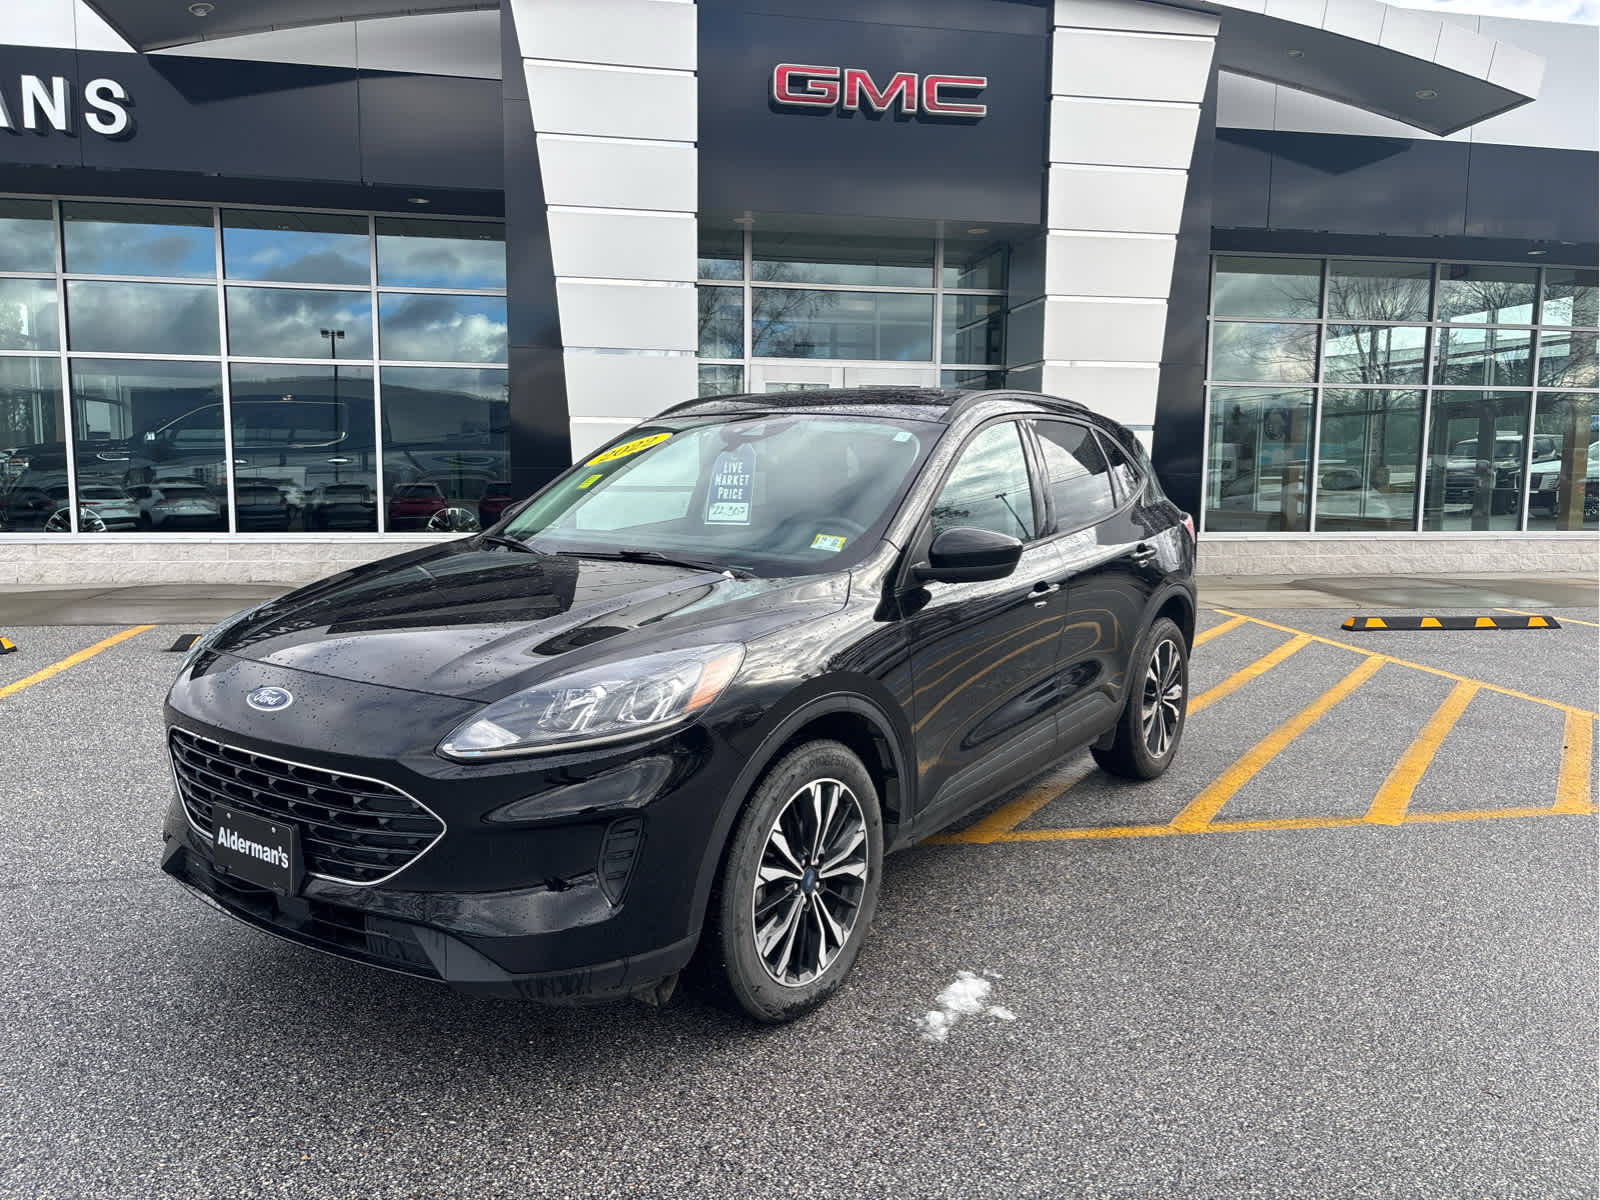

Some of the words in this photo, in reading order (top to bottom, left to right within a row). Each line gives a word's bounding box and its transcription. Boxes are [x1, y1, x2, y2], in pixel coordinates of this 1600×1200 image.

[773, 62, 988, 117] GMC
[0, 74, 128, 135] NS
[714, 473, 750, 487] MARKET
[723, 462, 743, 474] LIVE
[718, 487, 743, 500] PRICE
[217, 826, 289, 869] Alderman's
